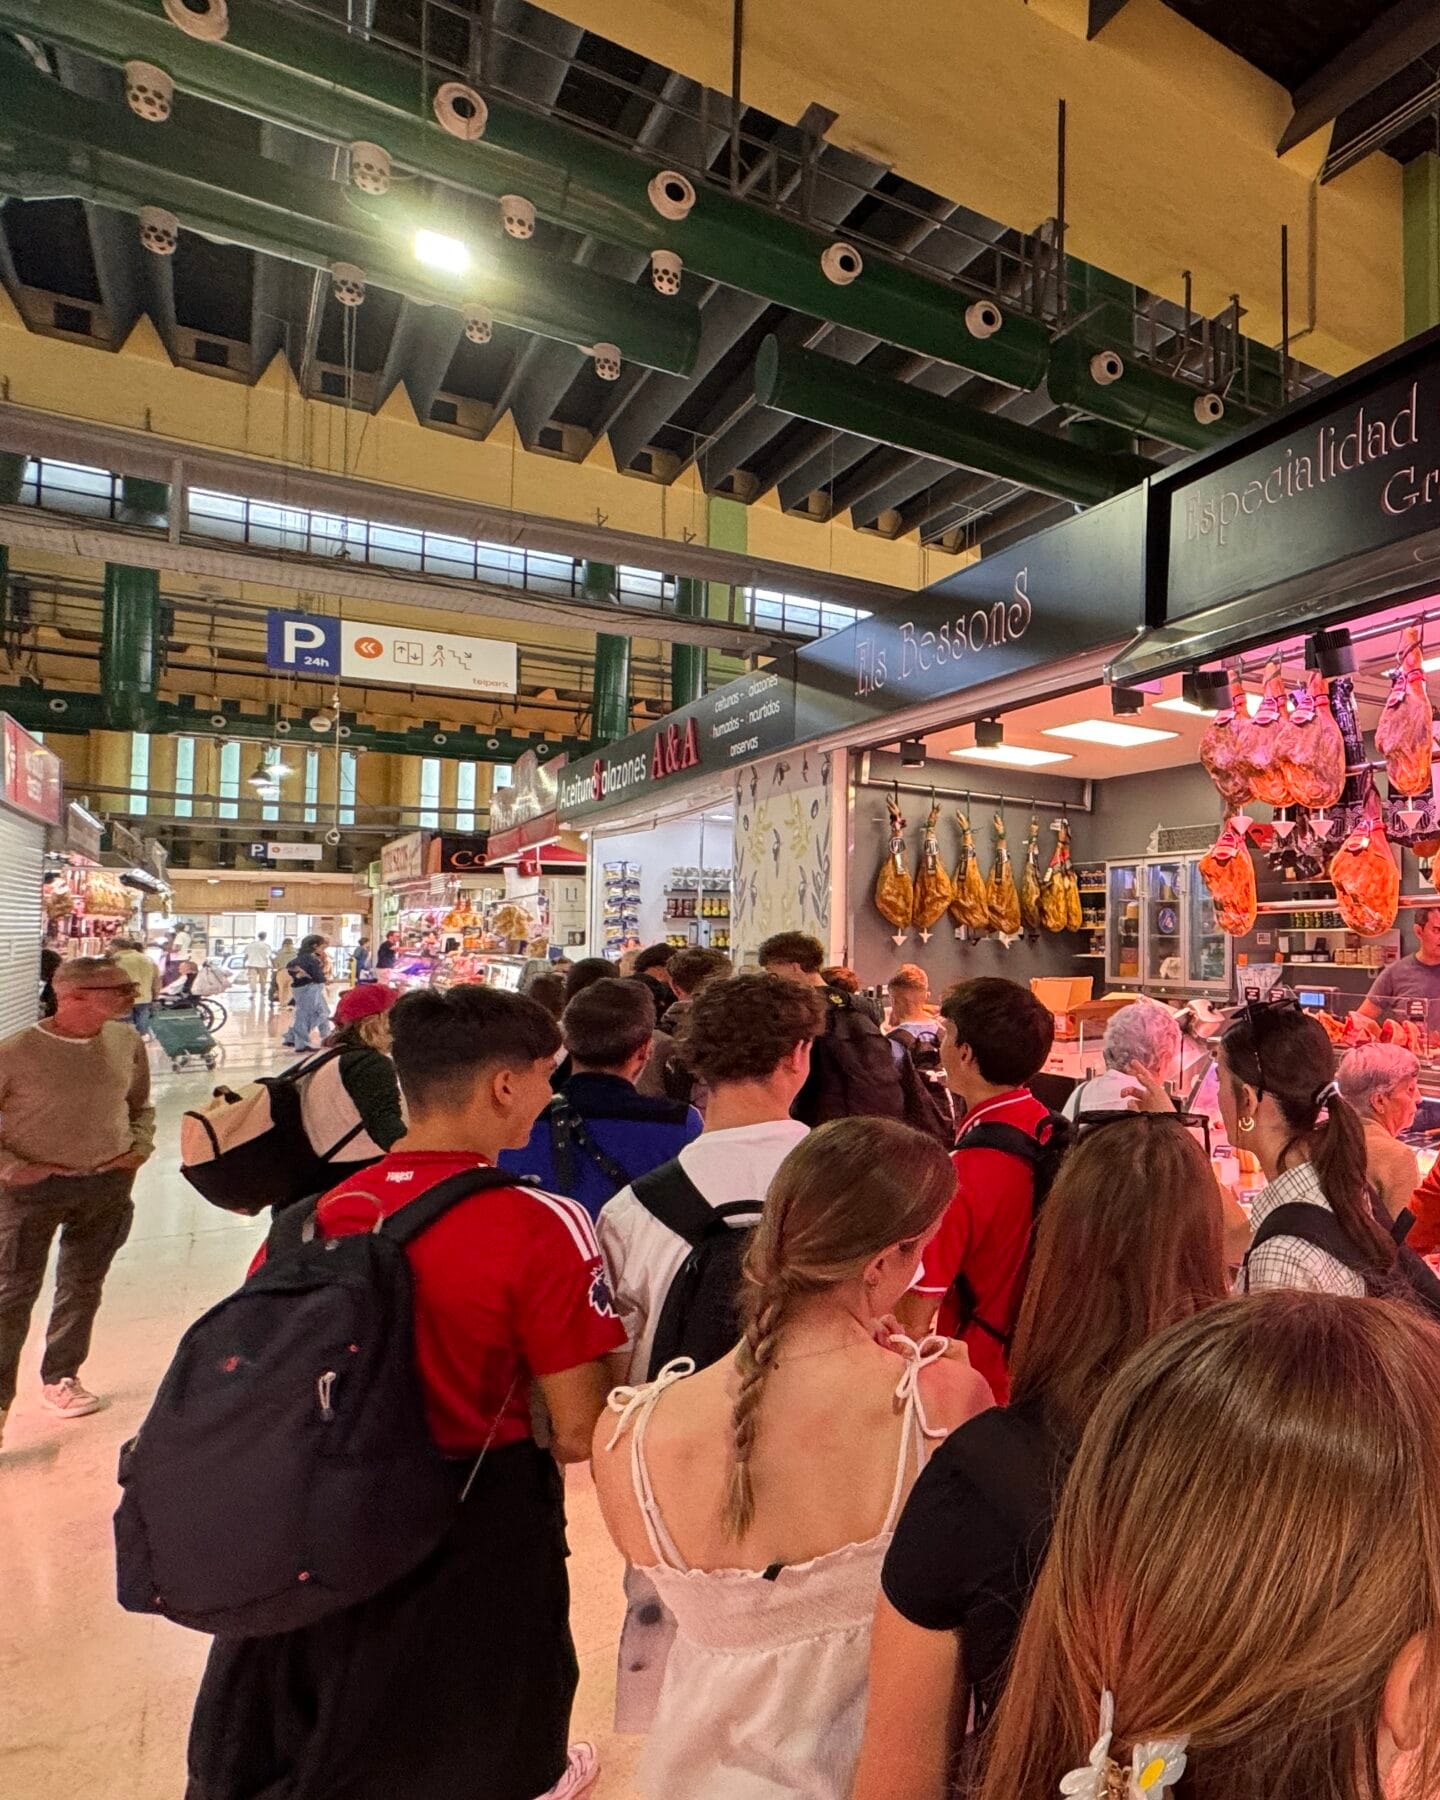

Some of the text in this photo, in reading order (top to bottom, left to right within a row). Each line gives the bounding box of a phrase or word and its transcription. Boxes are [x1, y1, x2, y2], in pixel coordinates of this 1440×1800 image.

[1186, 381, 1419, 547] Especialidad
[283, 621, 326, 663] P
[303, 655, 329, 668] 24h
[855, 638, 888, 697] Els
[713, 691, 740, 713] ceitunas
[712, 716, 740, 739] humados
[651, 717, 700, 780] A&A
[730, 736, 759, 757] onservas
